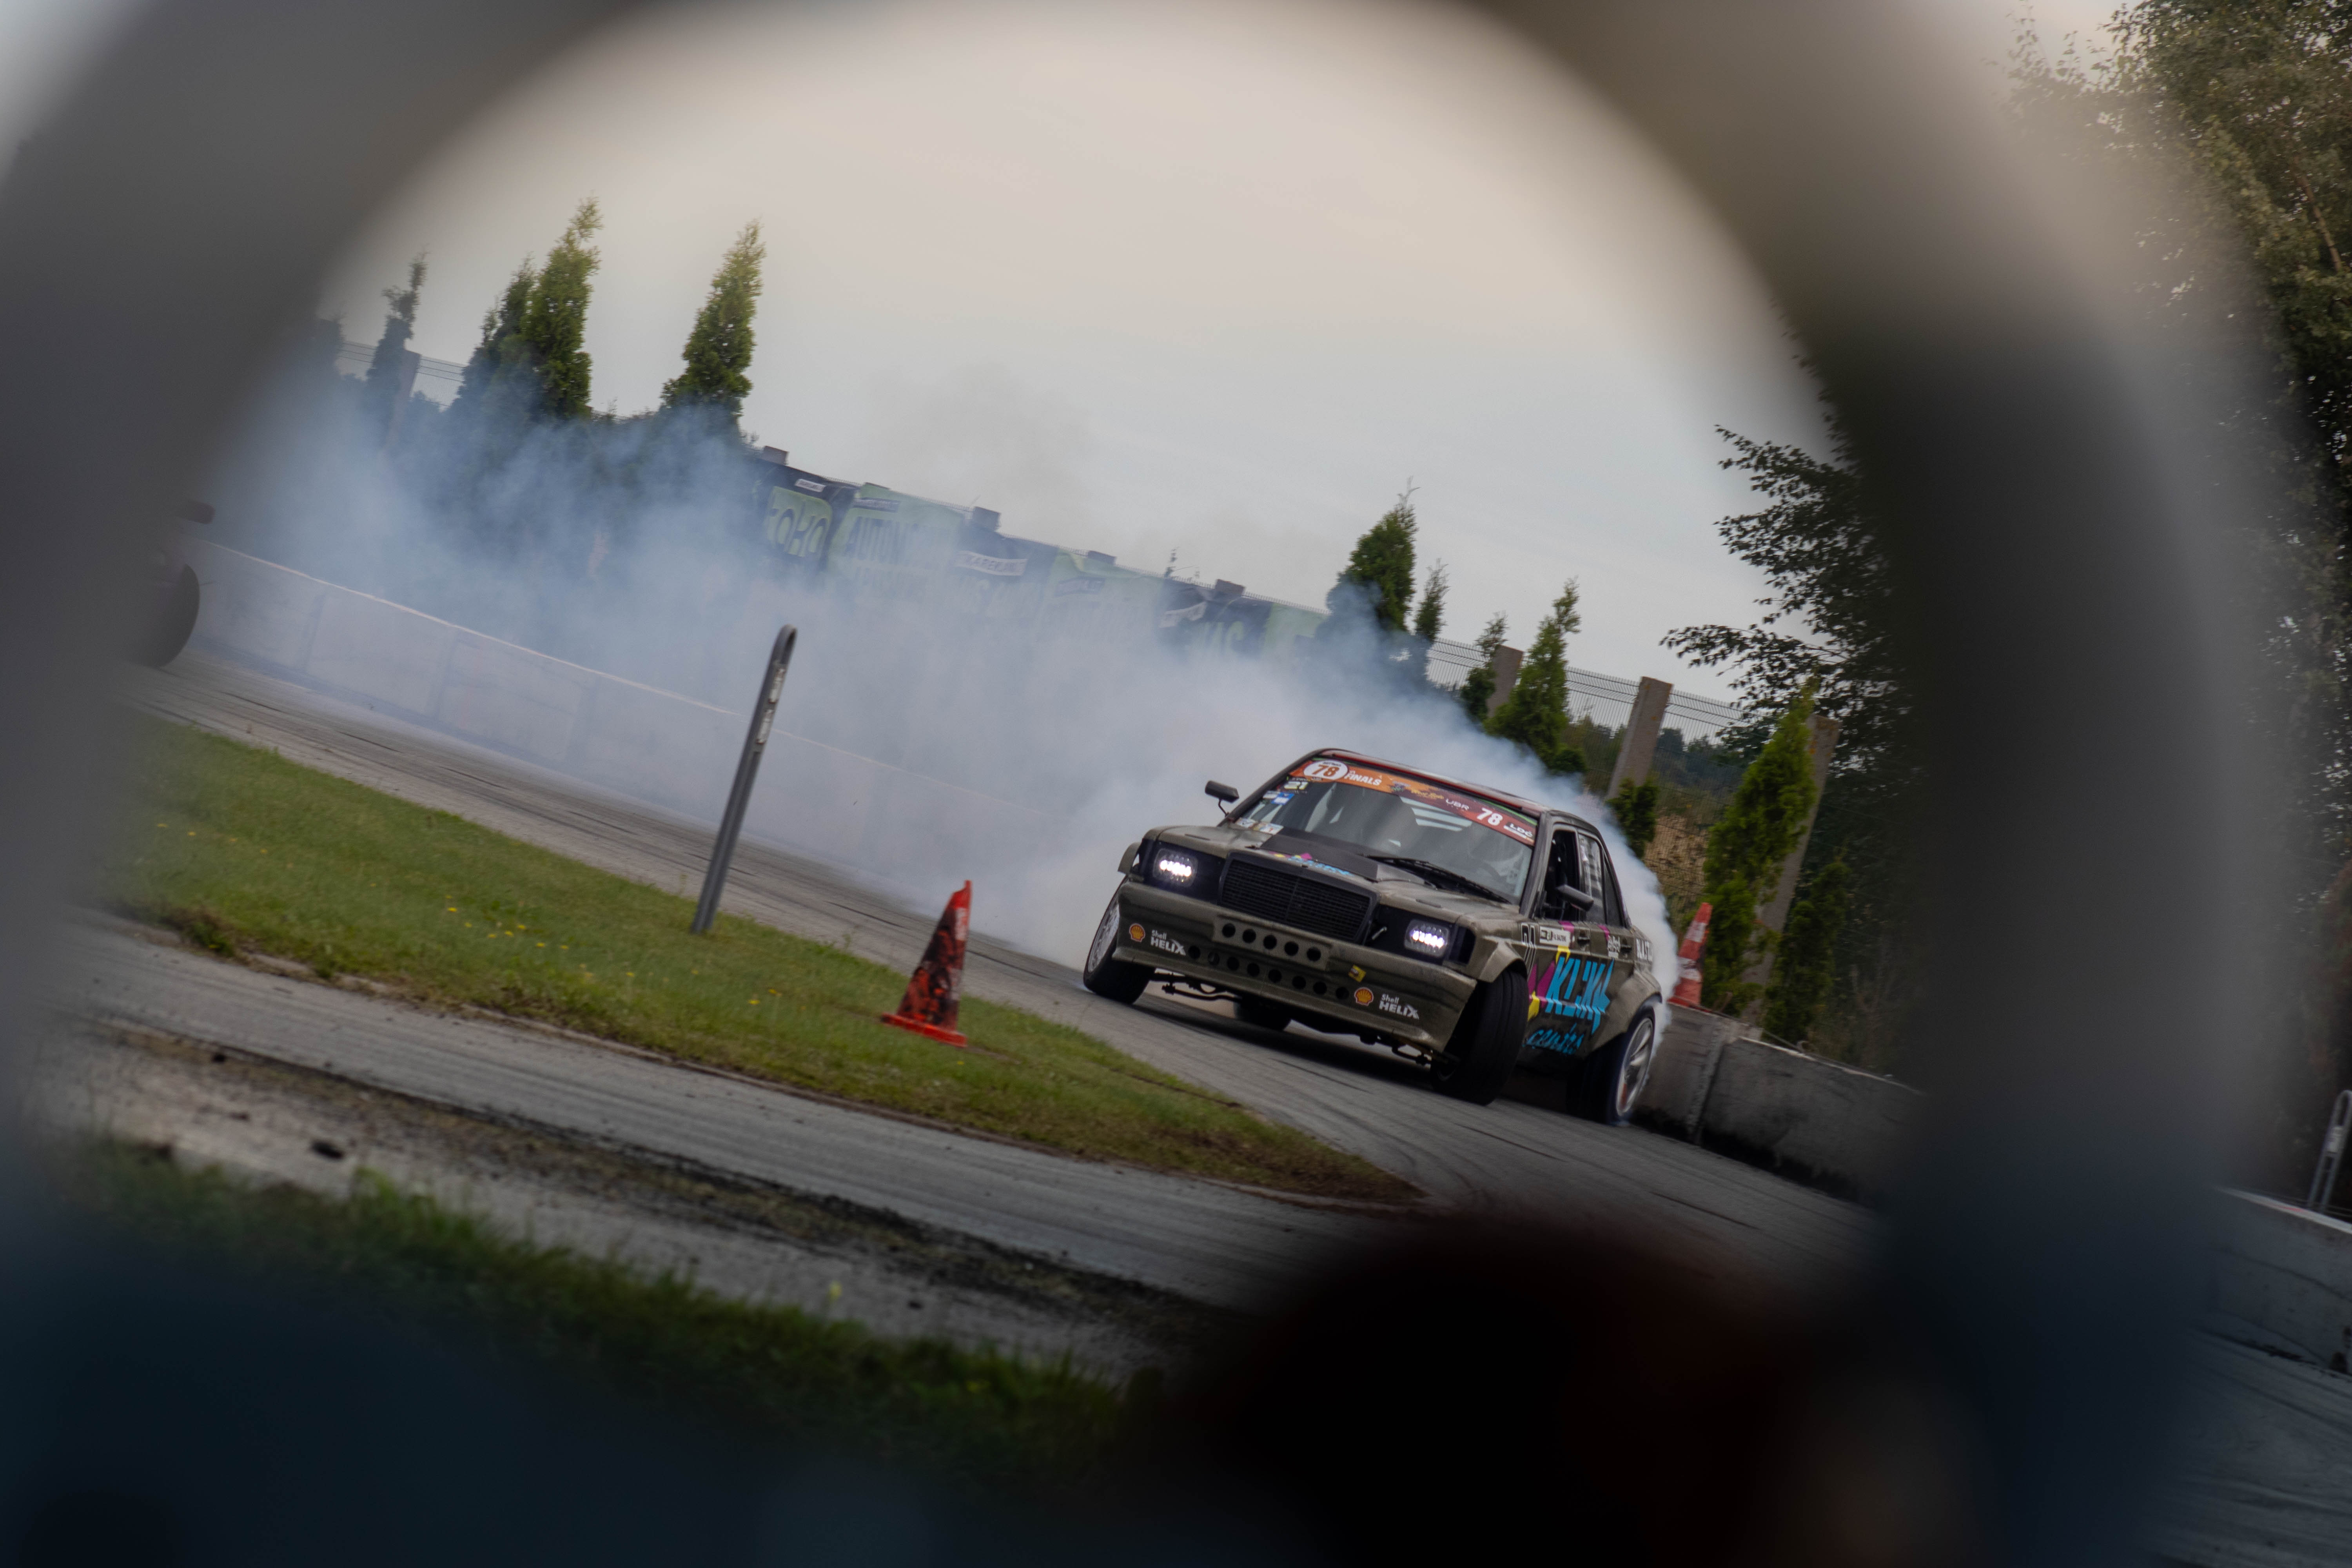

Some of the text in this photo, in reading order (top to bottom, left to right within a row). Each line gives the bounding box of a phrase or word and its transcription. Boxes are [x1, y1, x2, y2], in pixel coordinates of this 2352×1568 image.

[1312, 765, 1339, 777] 78
[1344, 773, 1382, 786] FINALS
[1446, 799, 1469, 811] UBR
[1477, 808, 1503, 826] 78
[1152, 930, 1167, 940] Shell
[1151, 936, 1186, 956] HELIX
[1382, 993, 1399, 1004] Shell
[1379, 1000, 1419, 1020] HELIX
